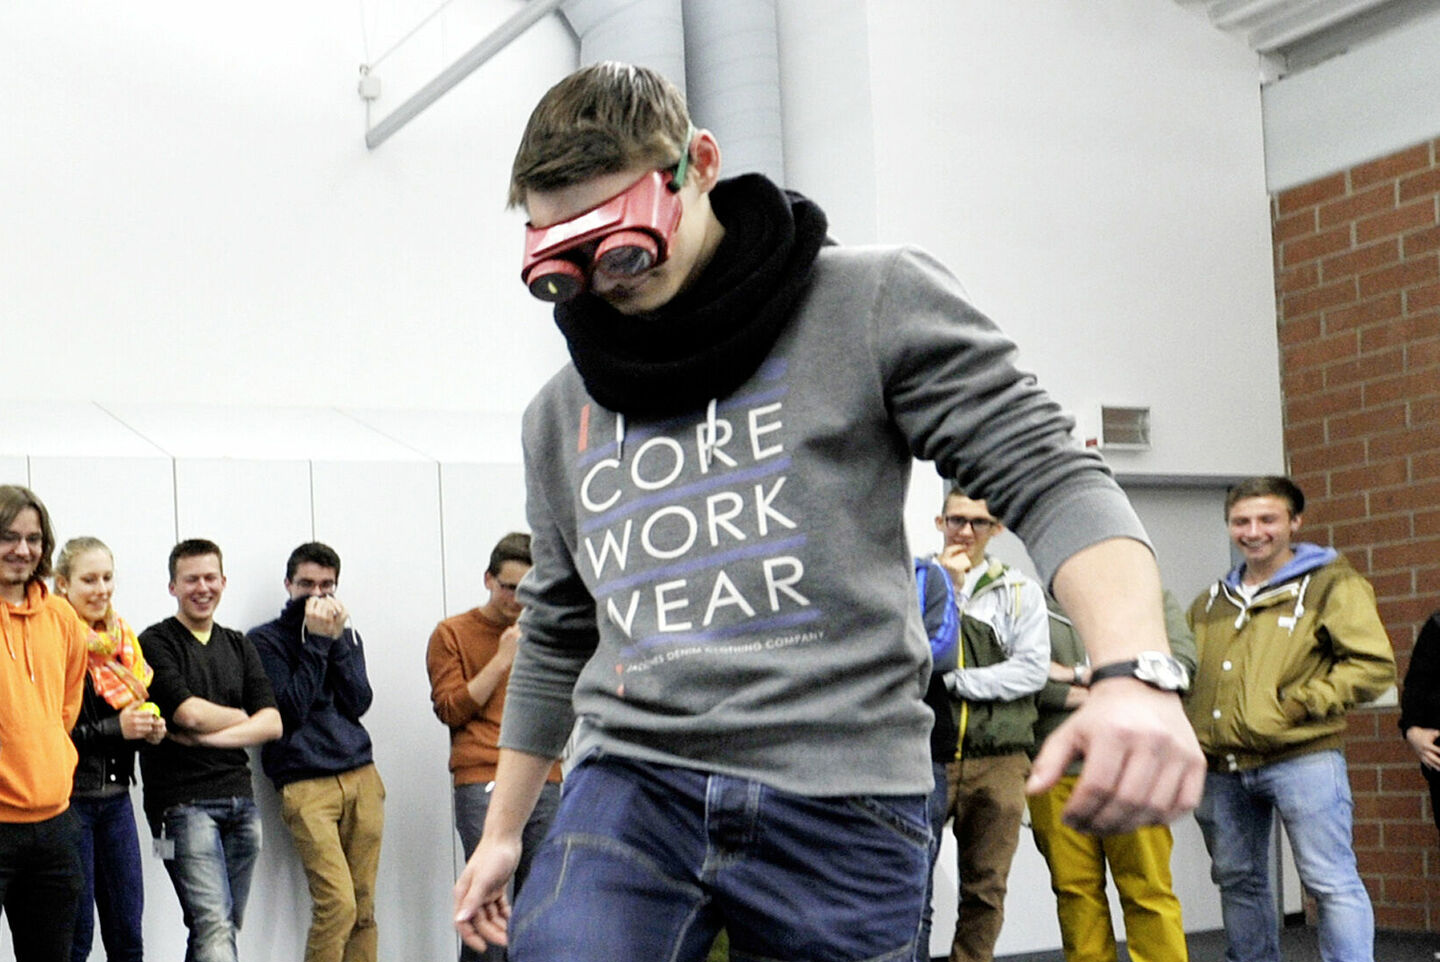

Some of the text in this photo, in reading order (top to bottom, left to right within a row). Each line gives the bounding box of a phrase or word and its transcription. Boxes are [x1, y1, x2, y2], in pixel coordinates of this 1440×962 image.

[580, 402, 784, 513] CORE
[584, 476, 798, 580] WORK
[765, 631, 825, 649] COMPANY
